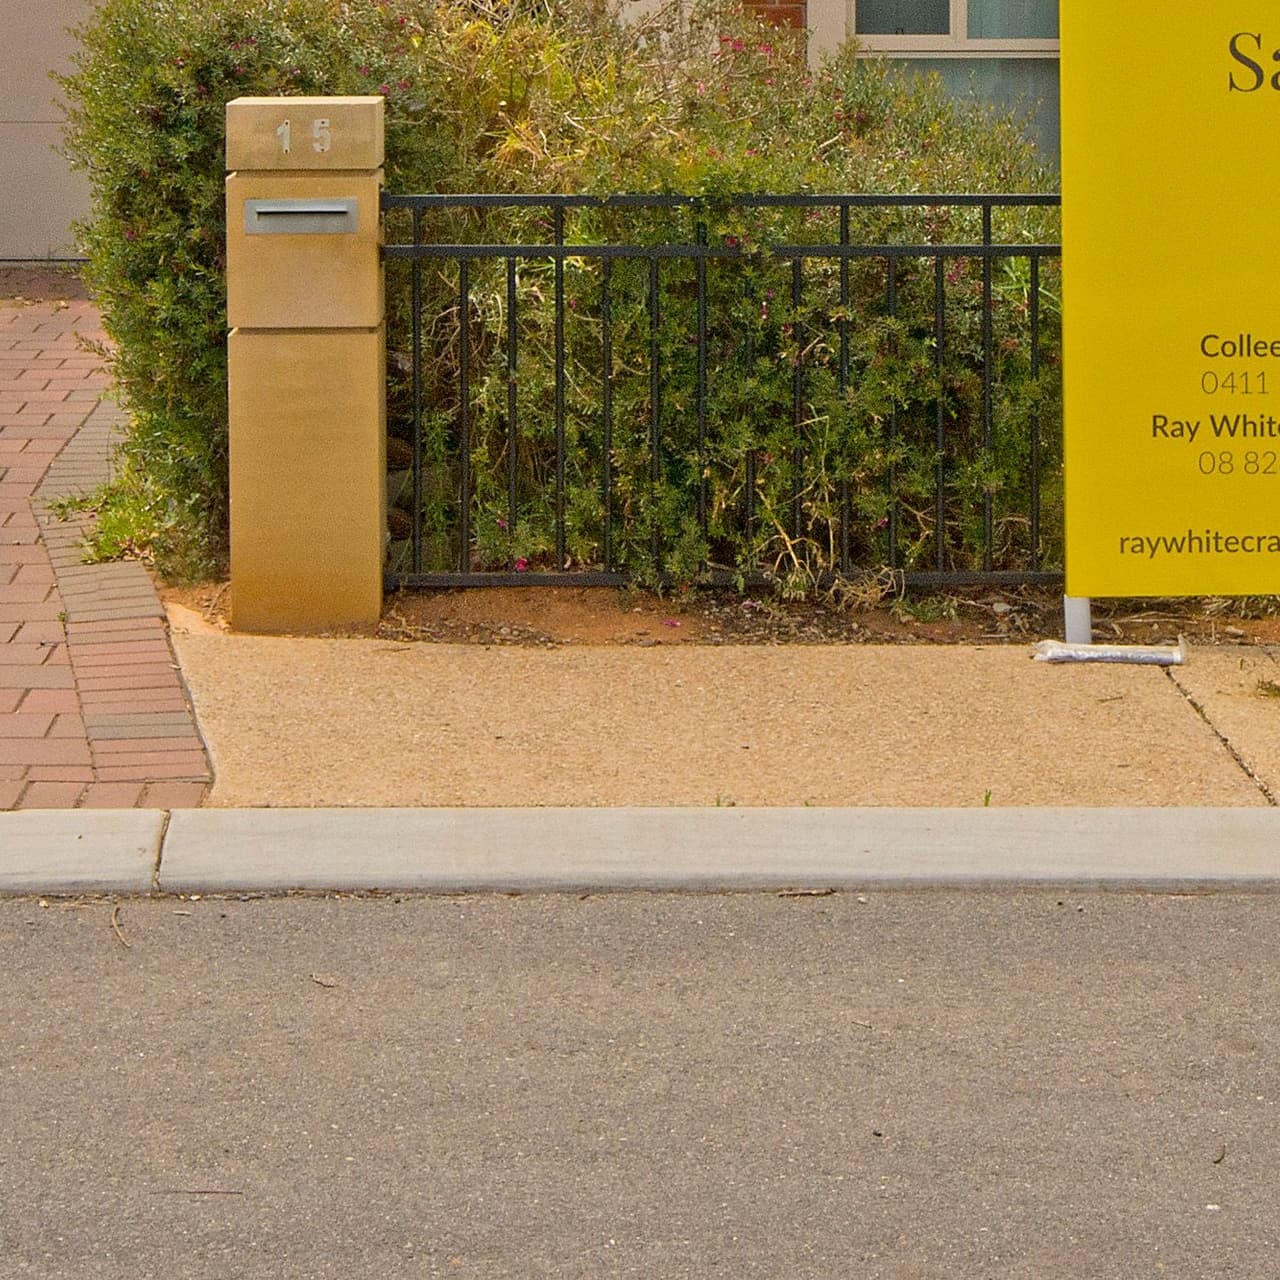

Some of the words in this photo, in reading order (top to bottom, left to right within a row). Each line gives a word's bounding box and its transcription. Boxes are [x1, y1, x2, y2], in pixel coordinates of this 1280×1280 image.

[276, 118, 332, 154] 15
[1201, 370, 1270, 395] 0411
[1152, 414, 1201, 442] Ray
[1198, 450, 1234, 475] 08
